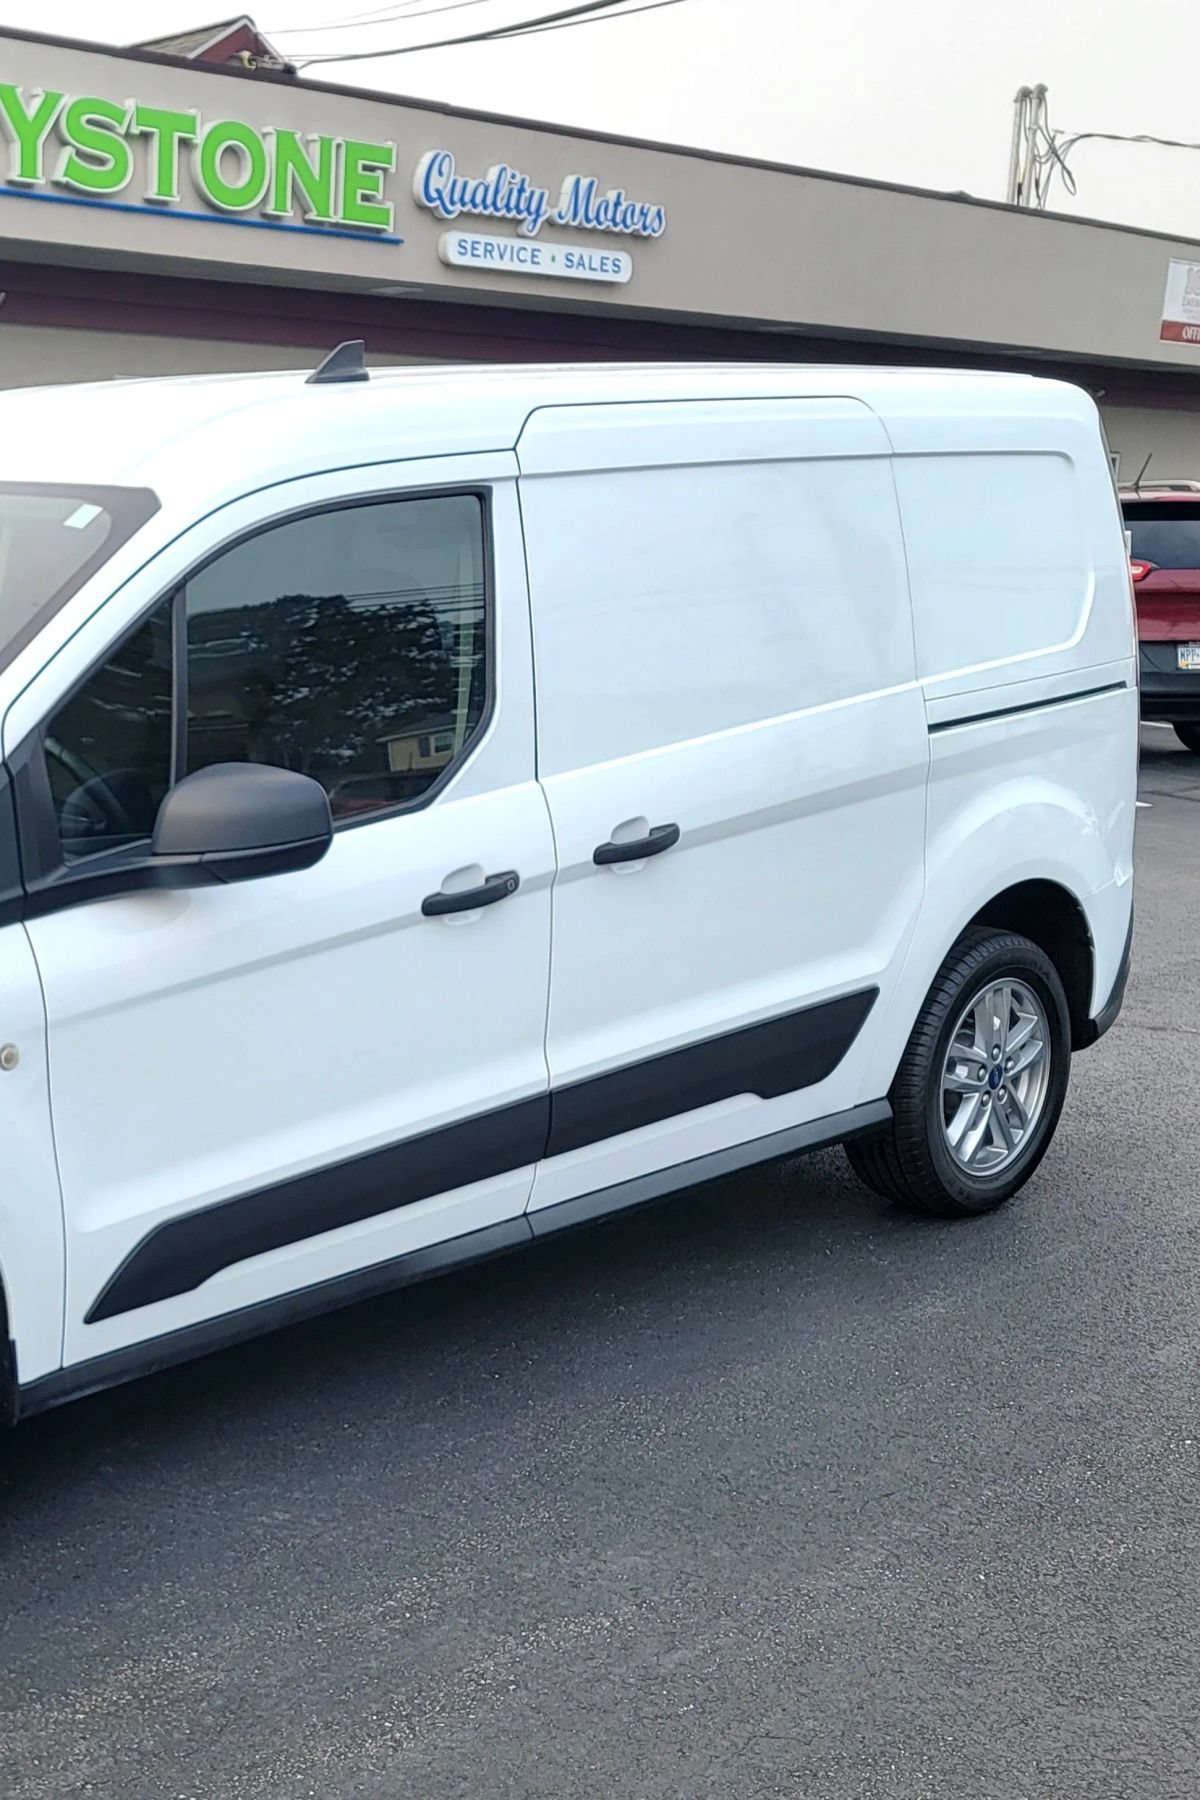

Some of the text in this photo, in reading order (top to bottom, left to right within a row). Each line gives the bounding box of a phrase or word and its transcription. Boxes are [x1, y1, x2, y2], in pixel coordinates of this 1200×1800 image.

[417, 151, 667, 236] Quality Motors
[456, 238, 623, 275] SERVICE SALES
